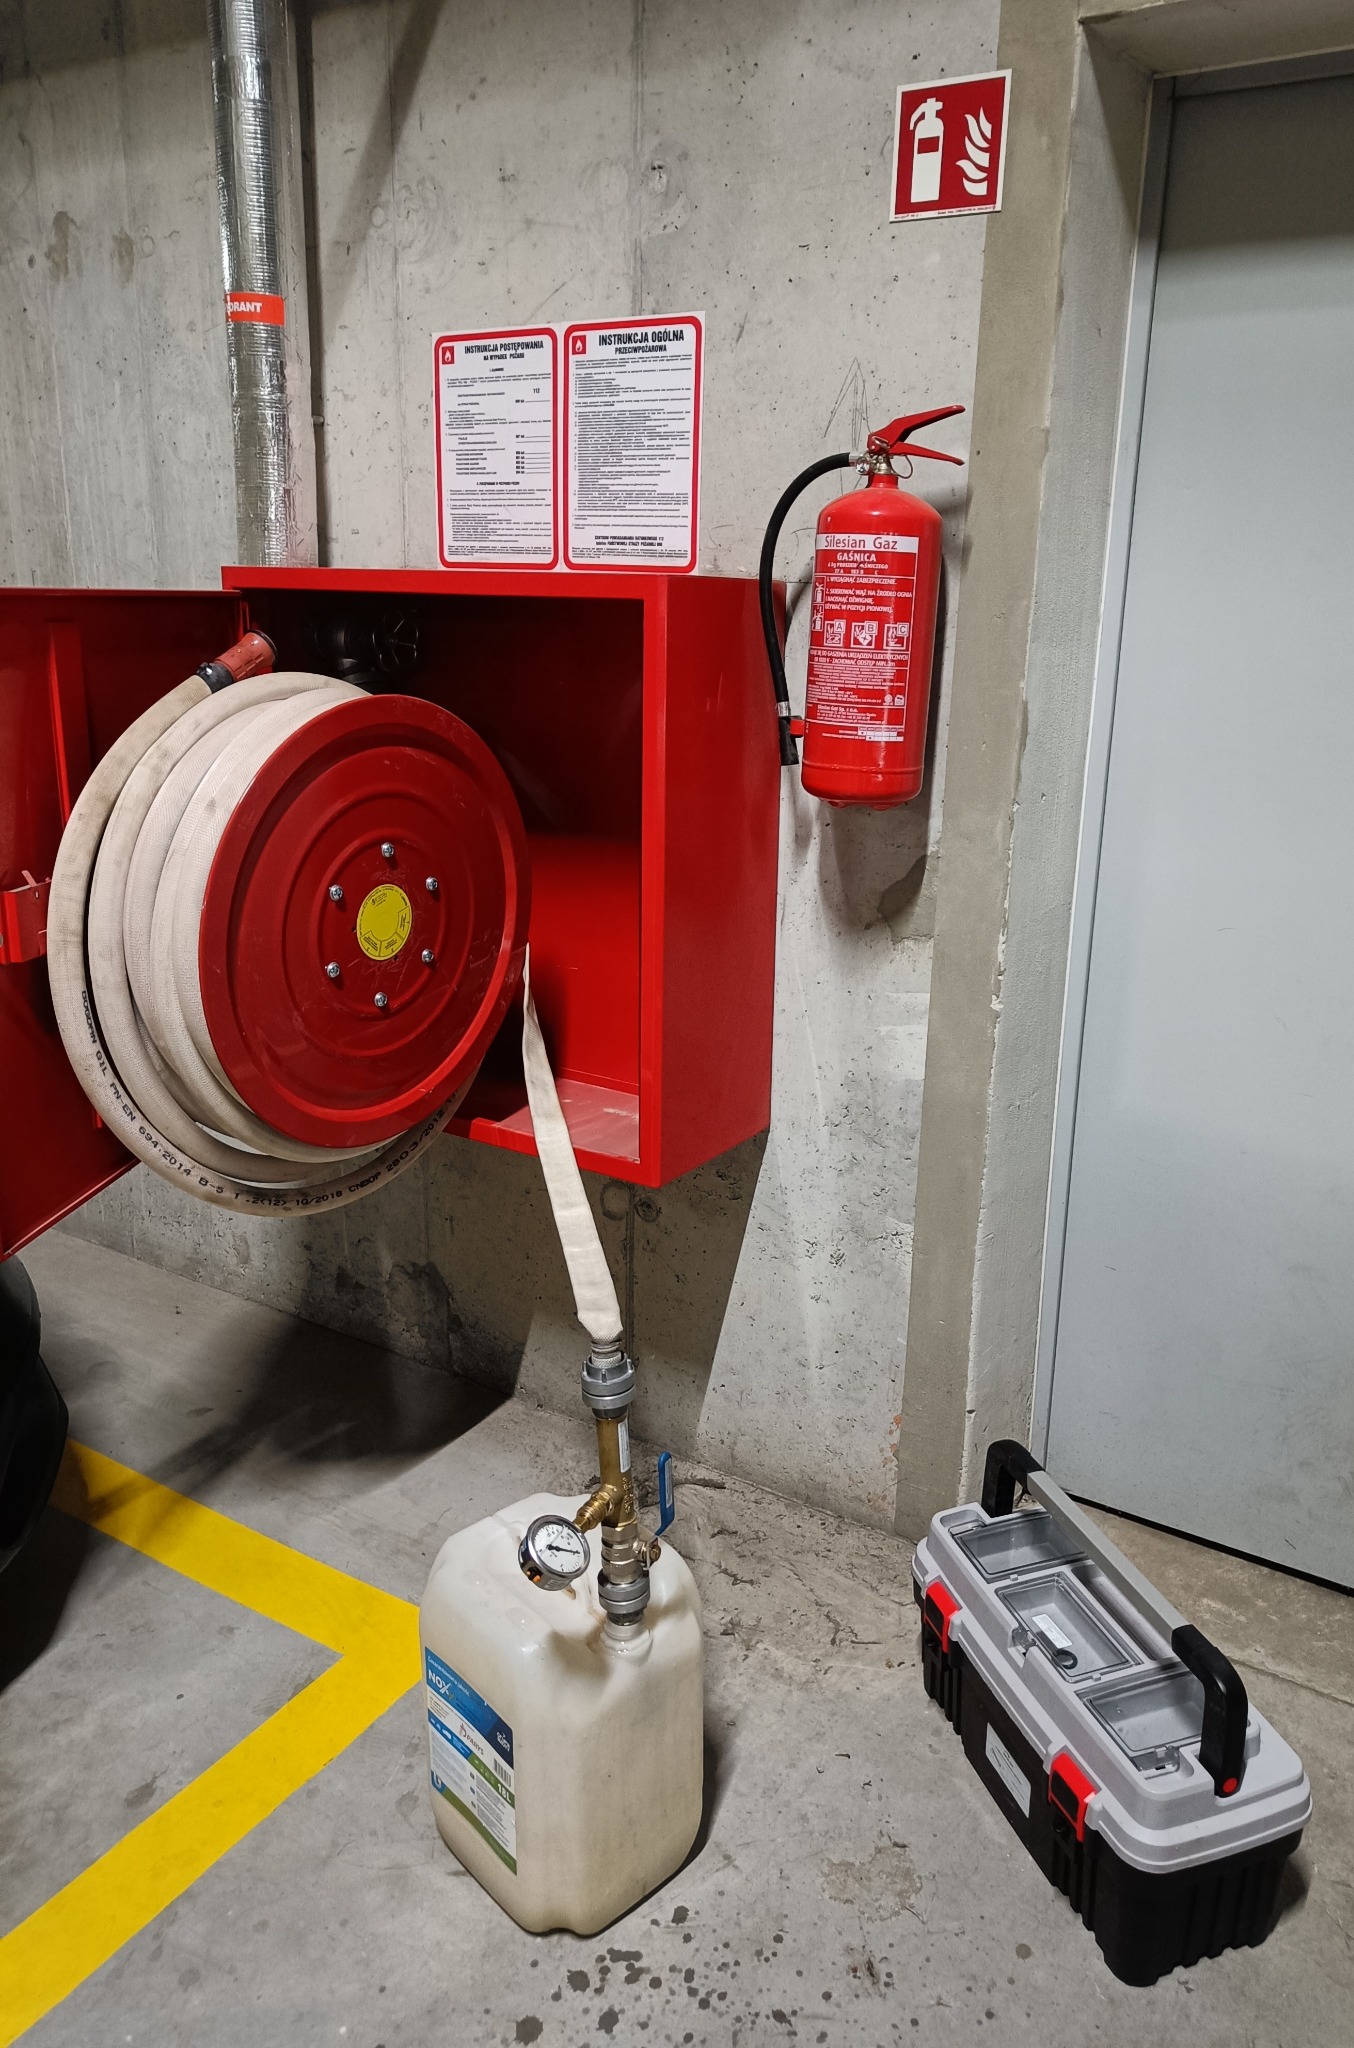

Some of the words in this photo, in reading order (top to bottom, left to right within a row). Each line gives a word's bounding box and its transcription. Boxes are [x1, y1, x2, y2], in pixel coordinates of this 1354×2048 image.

[598, 332, 649, 346] INSTRUKCJA
[652, 328, 684, 342] OGÓLNA
[464, 345, 498, 354] INSTRUKCJA
[499, 340, 544, 353] POSTĘPOWANIA
[614, 345, 667, 355] PRZECIWPOŻAROWA
[824, 535, 866, 548] Silesian
[873, 536, 898, 550] Gaz
[837, 551, 876, 562] GAŚNICA
[867, 624, 875, 632] B
[900, 625, 907, 634] C
[109, 1082, 137, 1122] PN-EN
[348, 1171, 382, 1193] CNBOP
